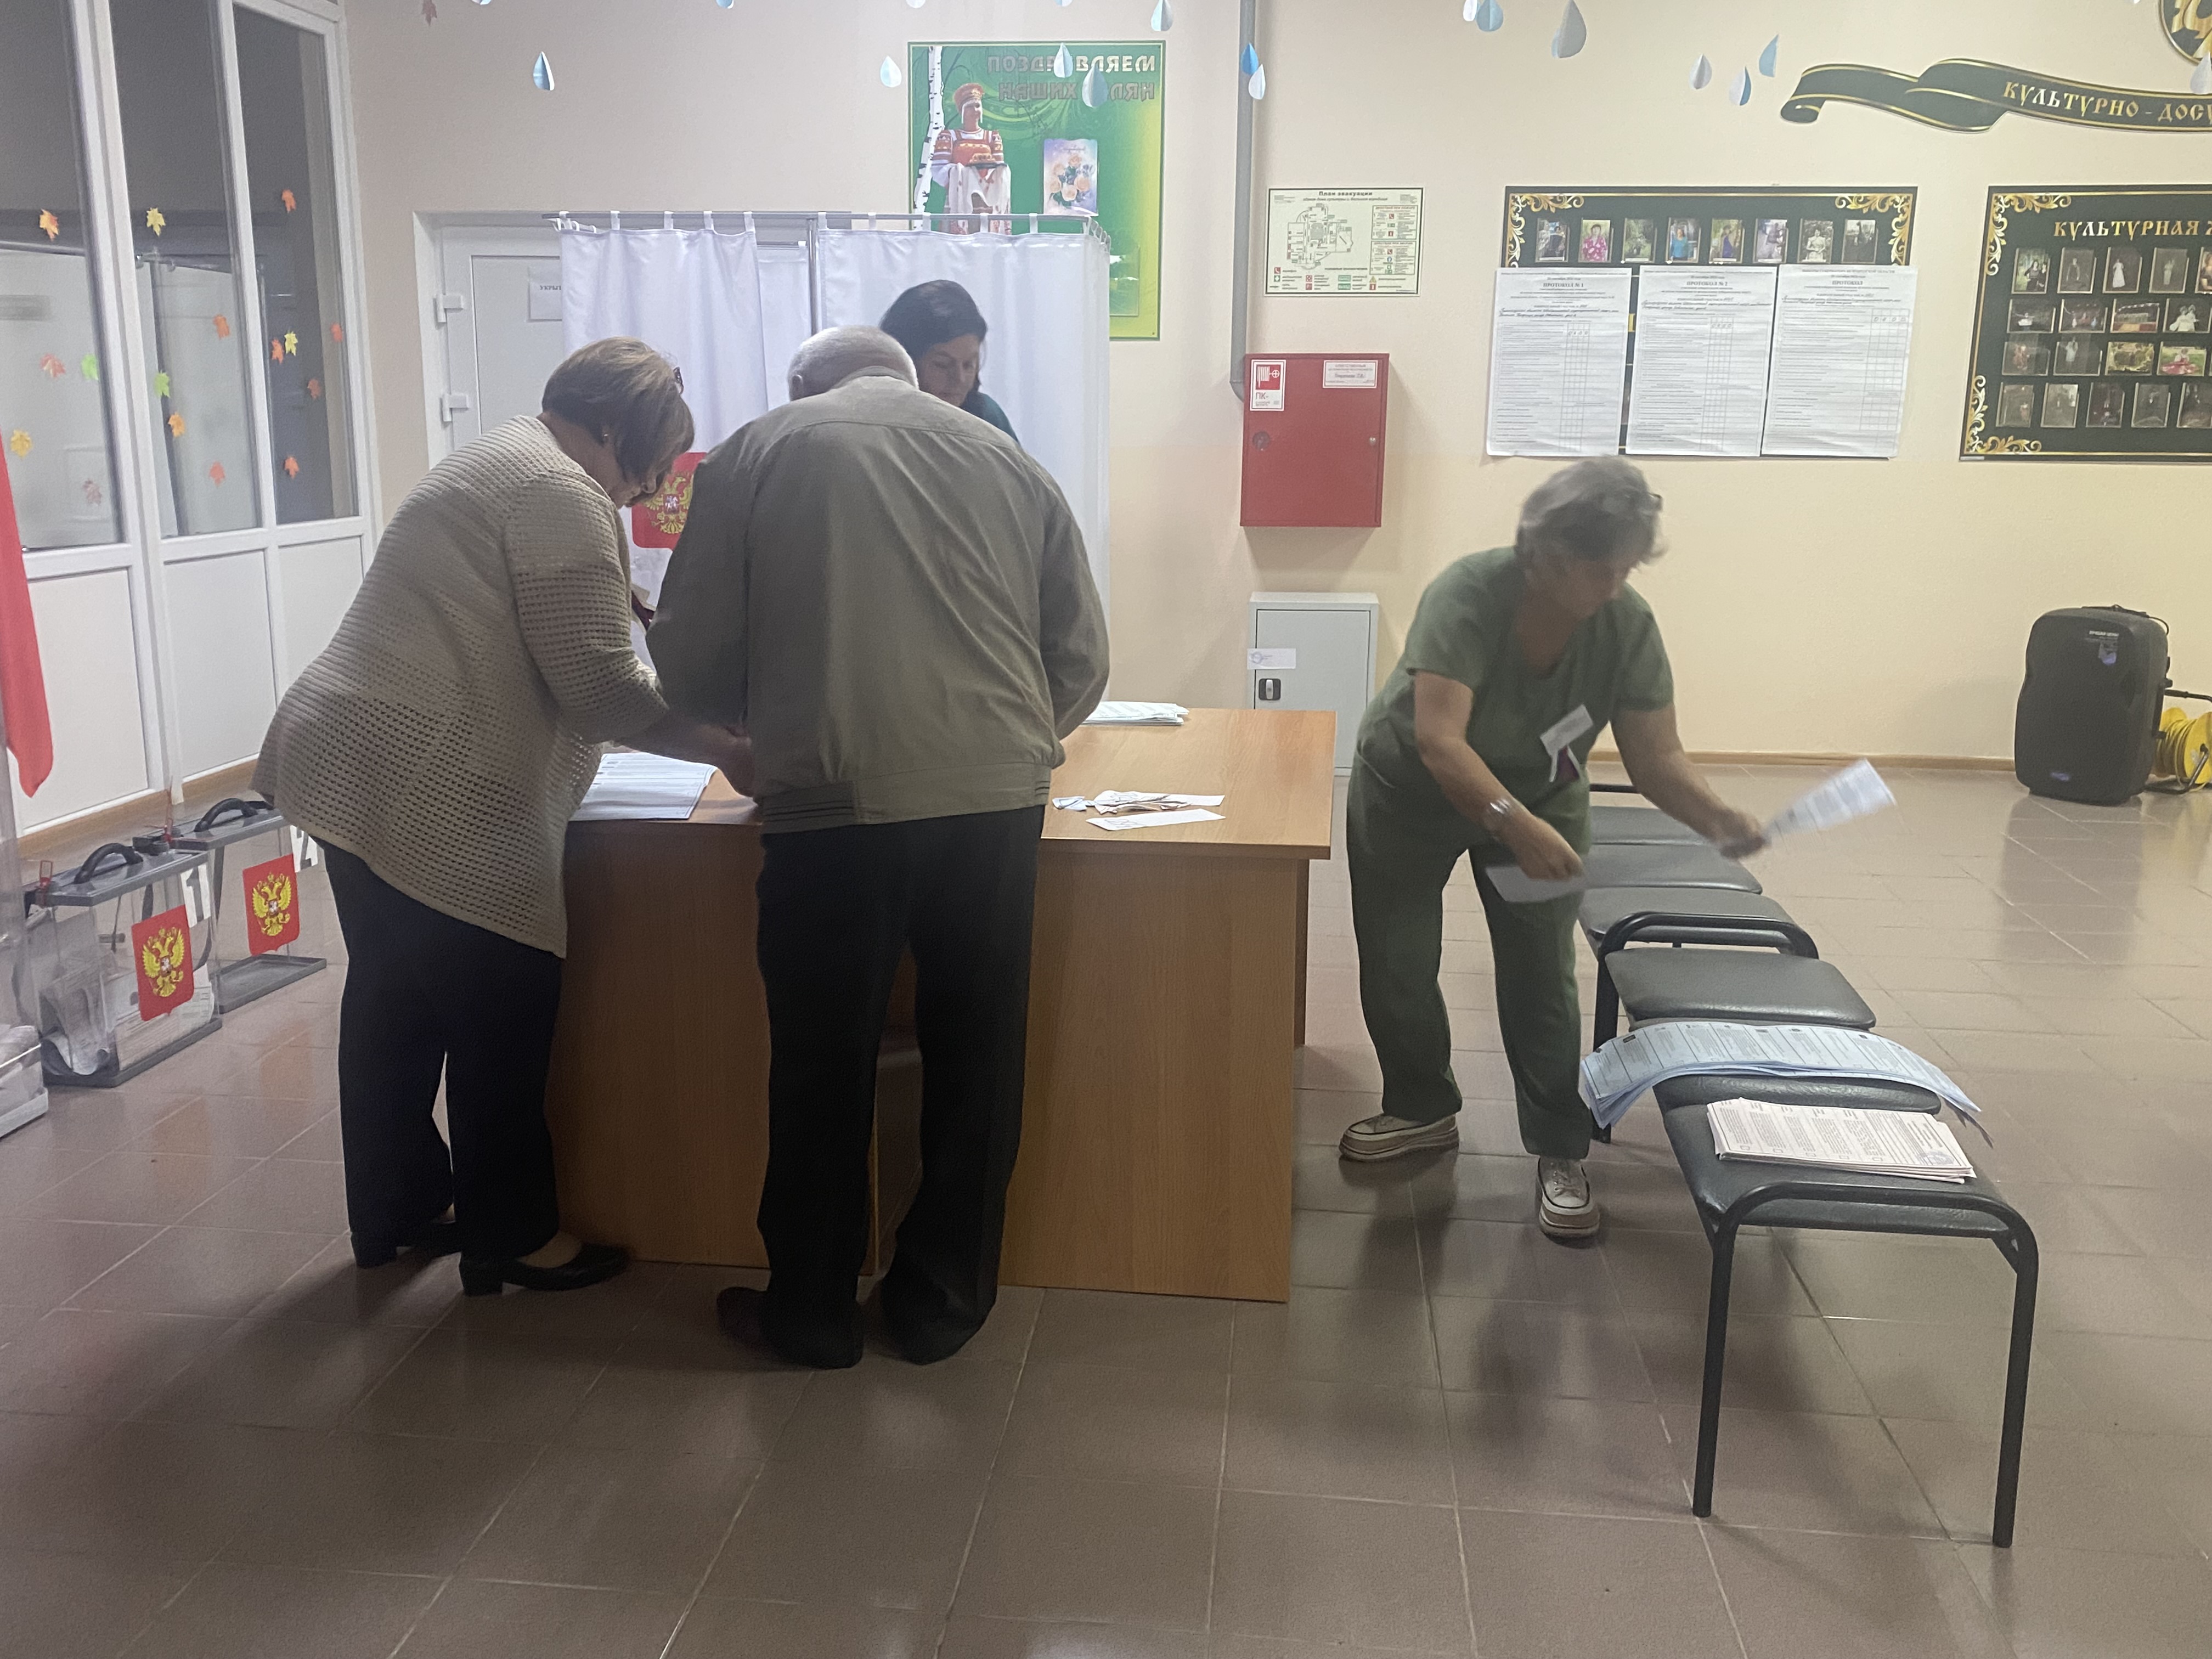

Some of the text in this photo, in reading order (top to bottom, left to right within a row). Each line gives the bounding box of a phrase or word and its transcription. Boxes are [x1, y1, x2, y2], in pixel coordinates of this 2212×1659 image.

[988, 55, 1155, 74] ПОЗДРВЛЯЕМ
[998, 82, 1078, 101] НАШИХ
[2003, 82, 2140, 117] КУЛЬТУРНО
[2053, 221, 2200, 241] КУЛЬТУРНАЯ
